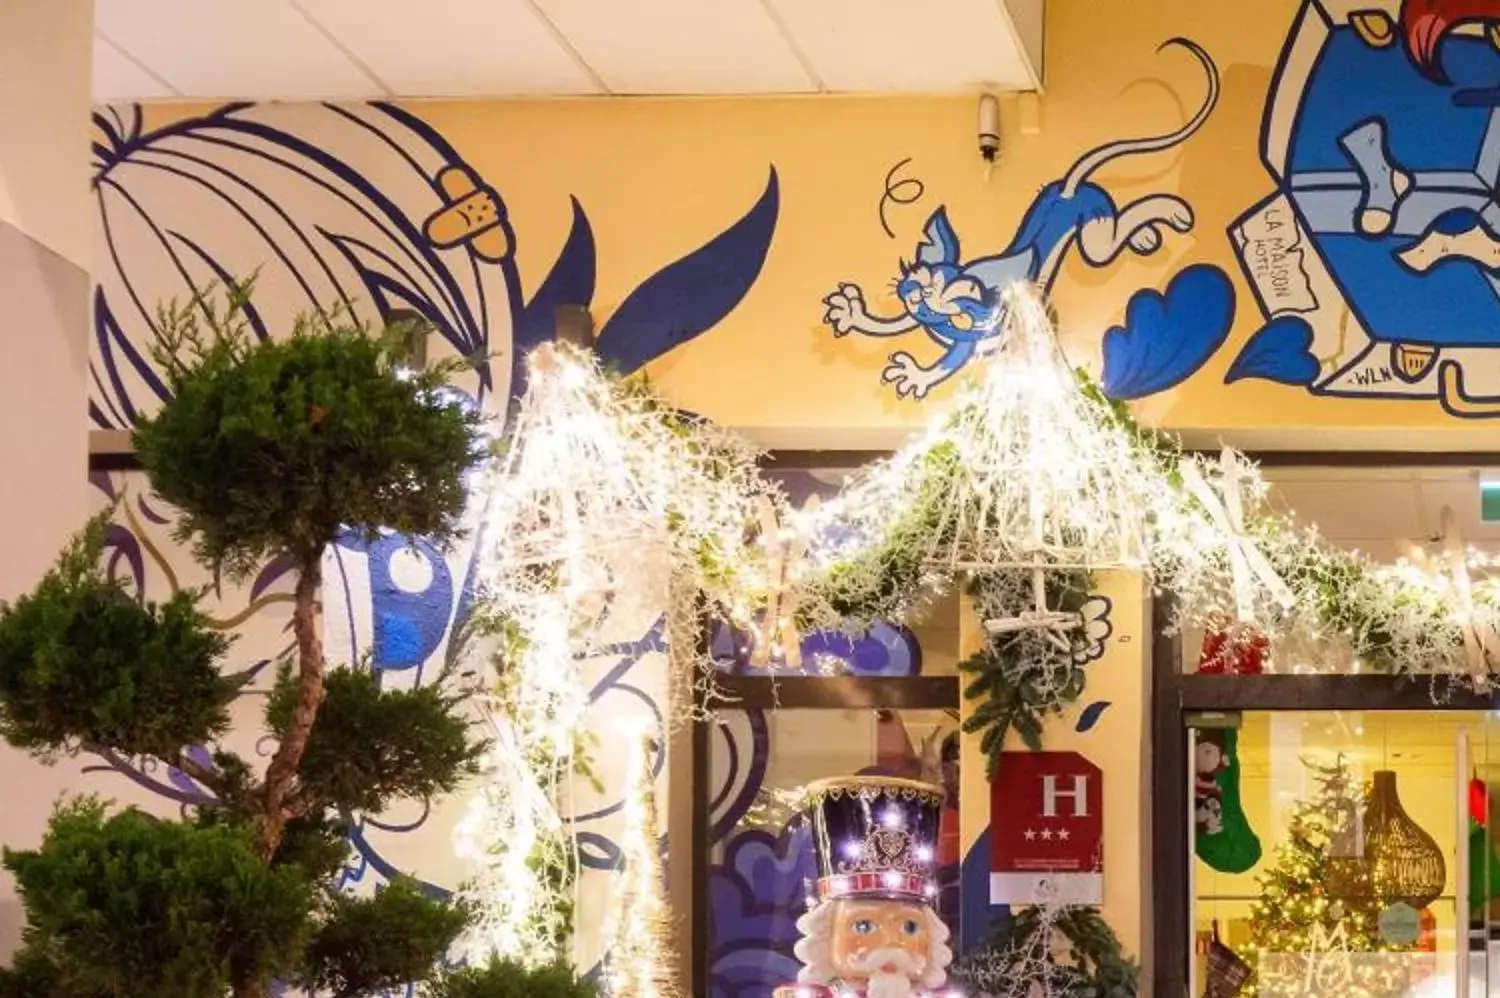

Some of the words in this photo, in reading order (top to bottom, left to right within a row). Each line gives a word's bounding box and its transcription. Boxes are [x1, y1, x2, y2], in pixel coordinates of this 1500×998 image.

[1263, 209, 1283, 233] LA
[1254, 239, 1270, 279] HOTEL
[1267, 237, 1292, 298] MAISON
[1354, 367, 1393, 386] WLN
[1038, 773, 1092, 818] H
